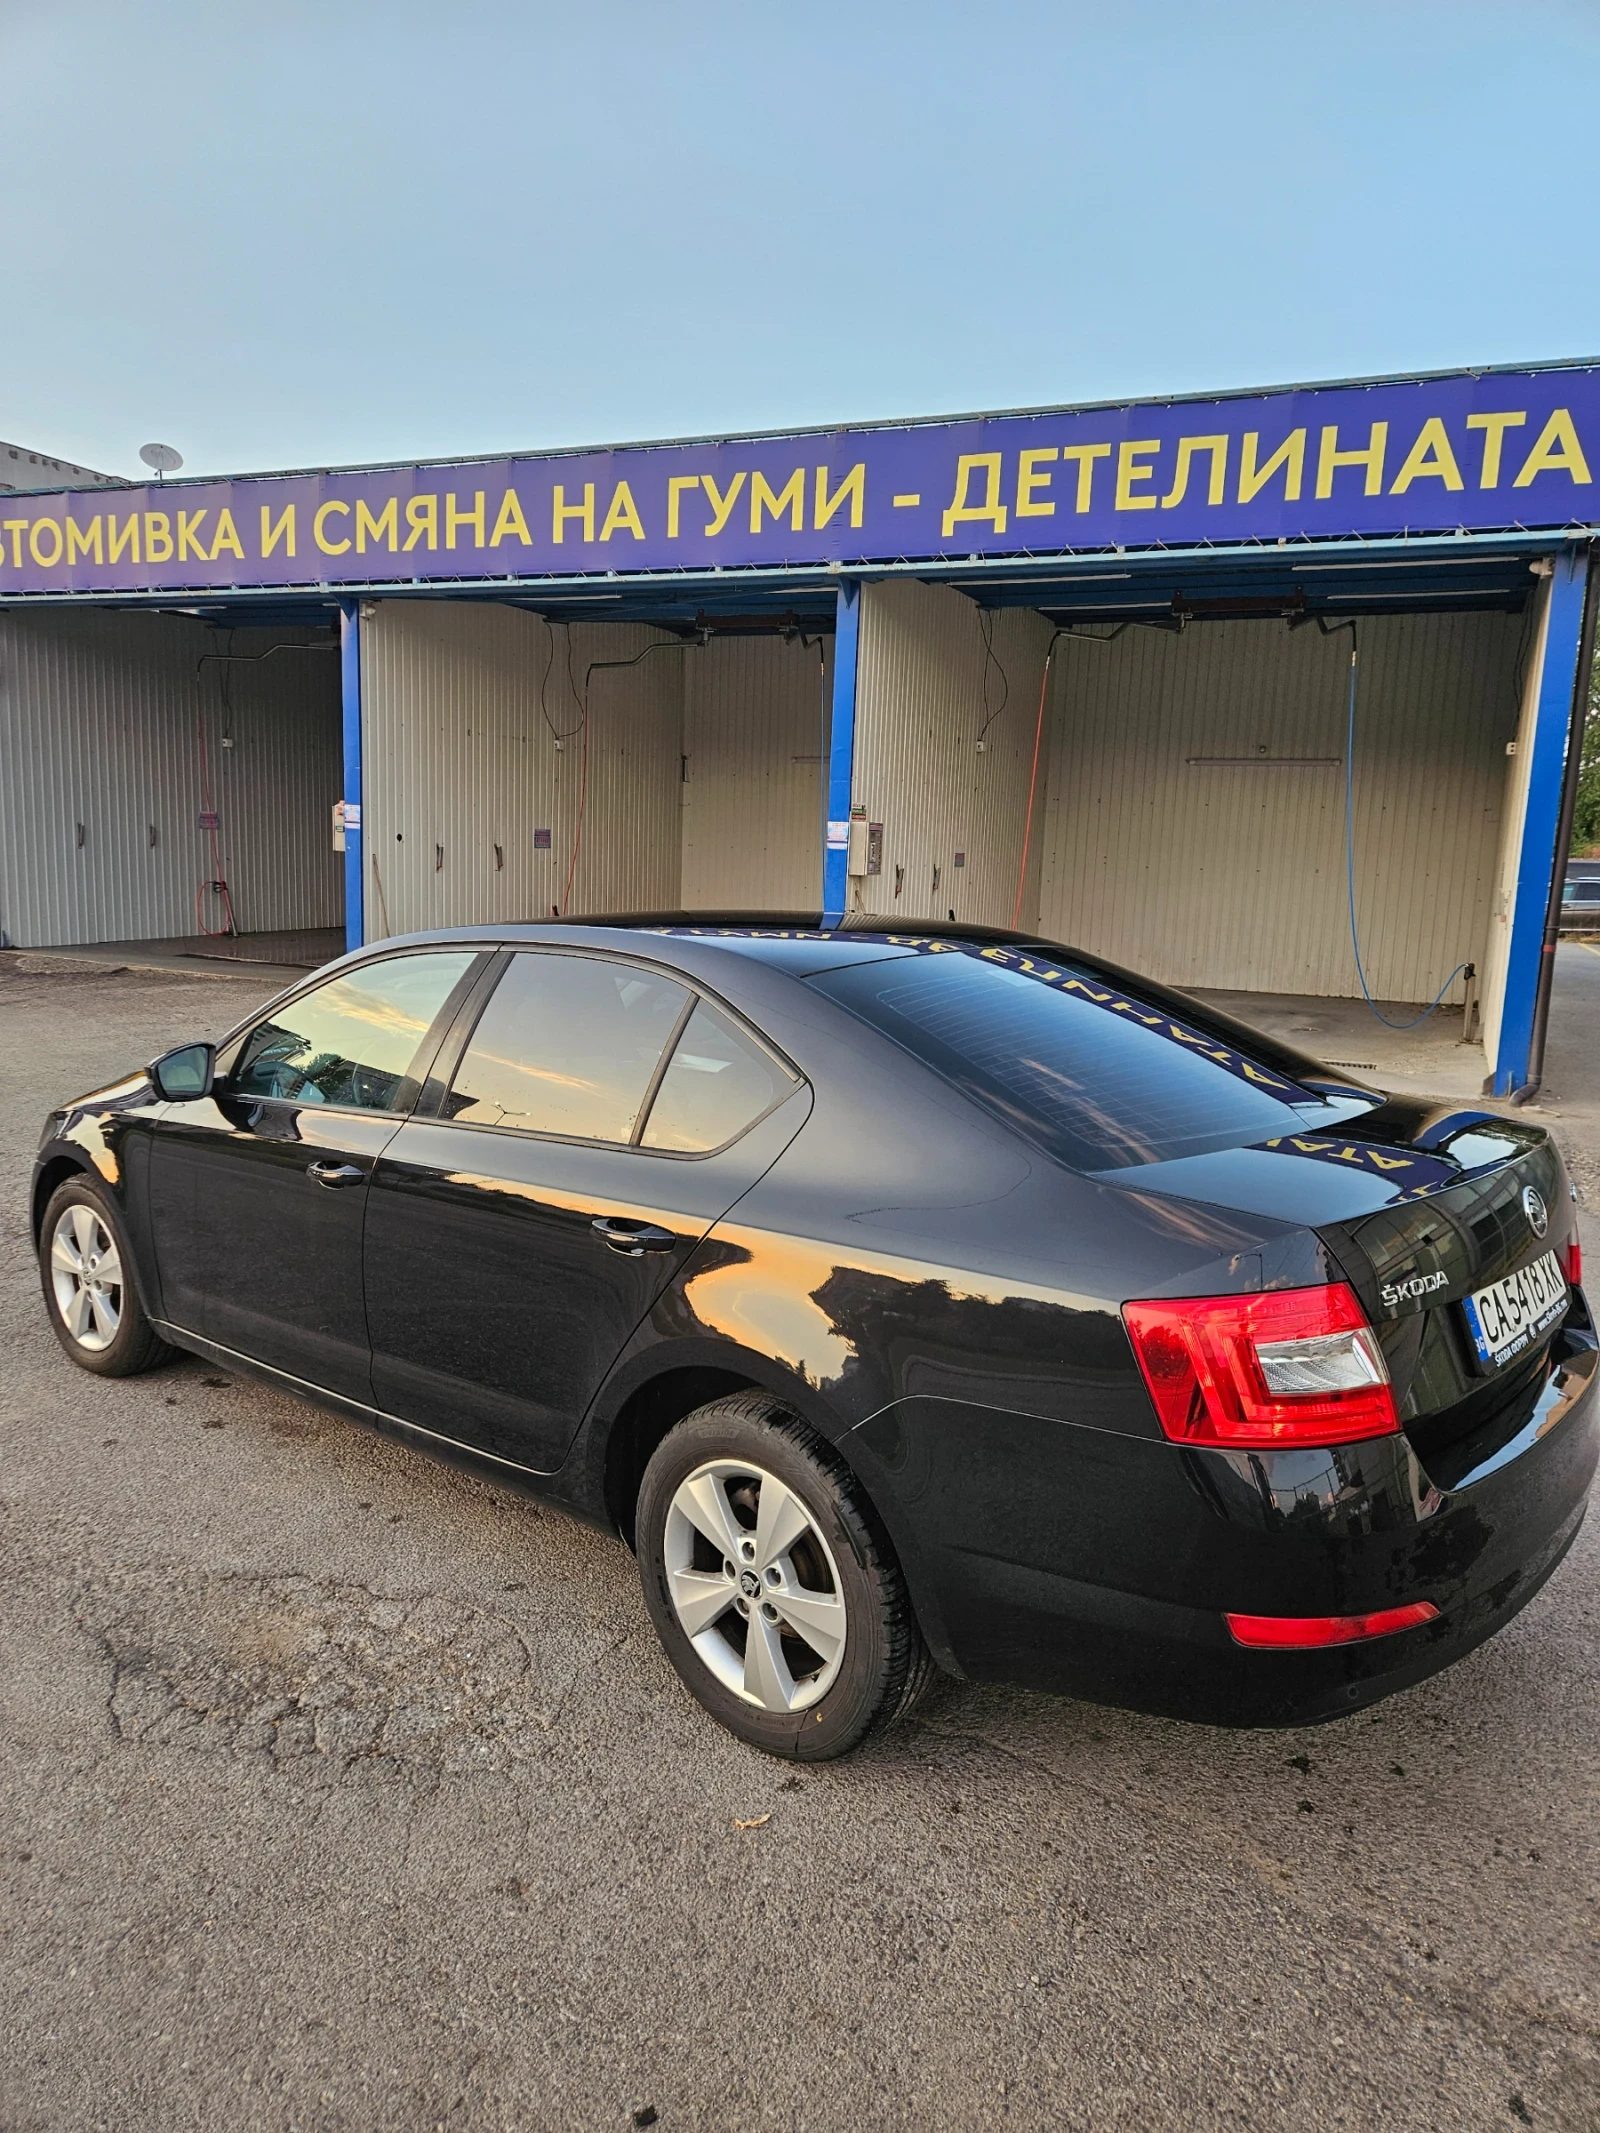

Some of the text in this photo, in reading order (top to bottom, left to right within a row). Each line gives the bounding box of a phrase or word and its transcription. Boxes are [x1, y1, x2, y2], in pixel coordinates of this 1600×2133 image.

[0, 409, 1591, 567] ТОМИВКА И СМЯНА НА ГУМИ - ДЕТЕЛИНАТА
[1381, 1270, 1450, 1307] ŠKODA
[1501, 1264, 1546, 1325] 5418
